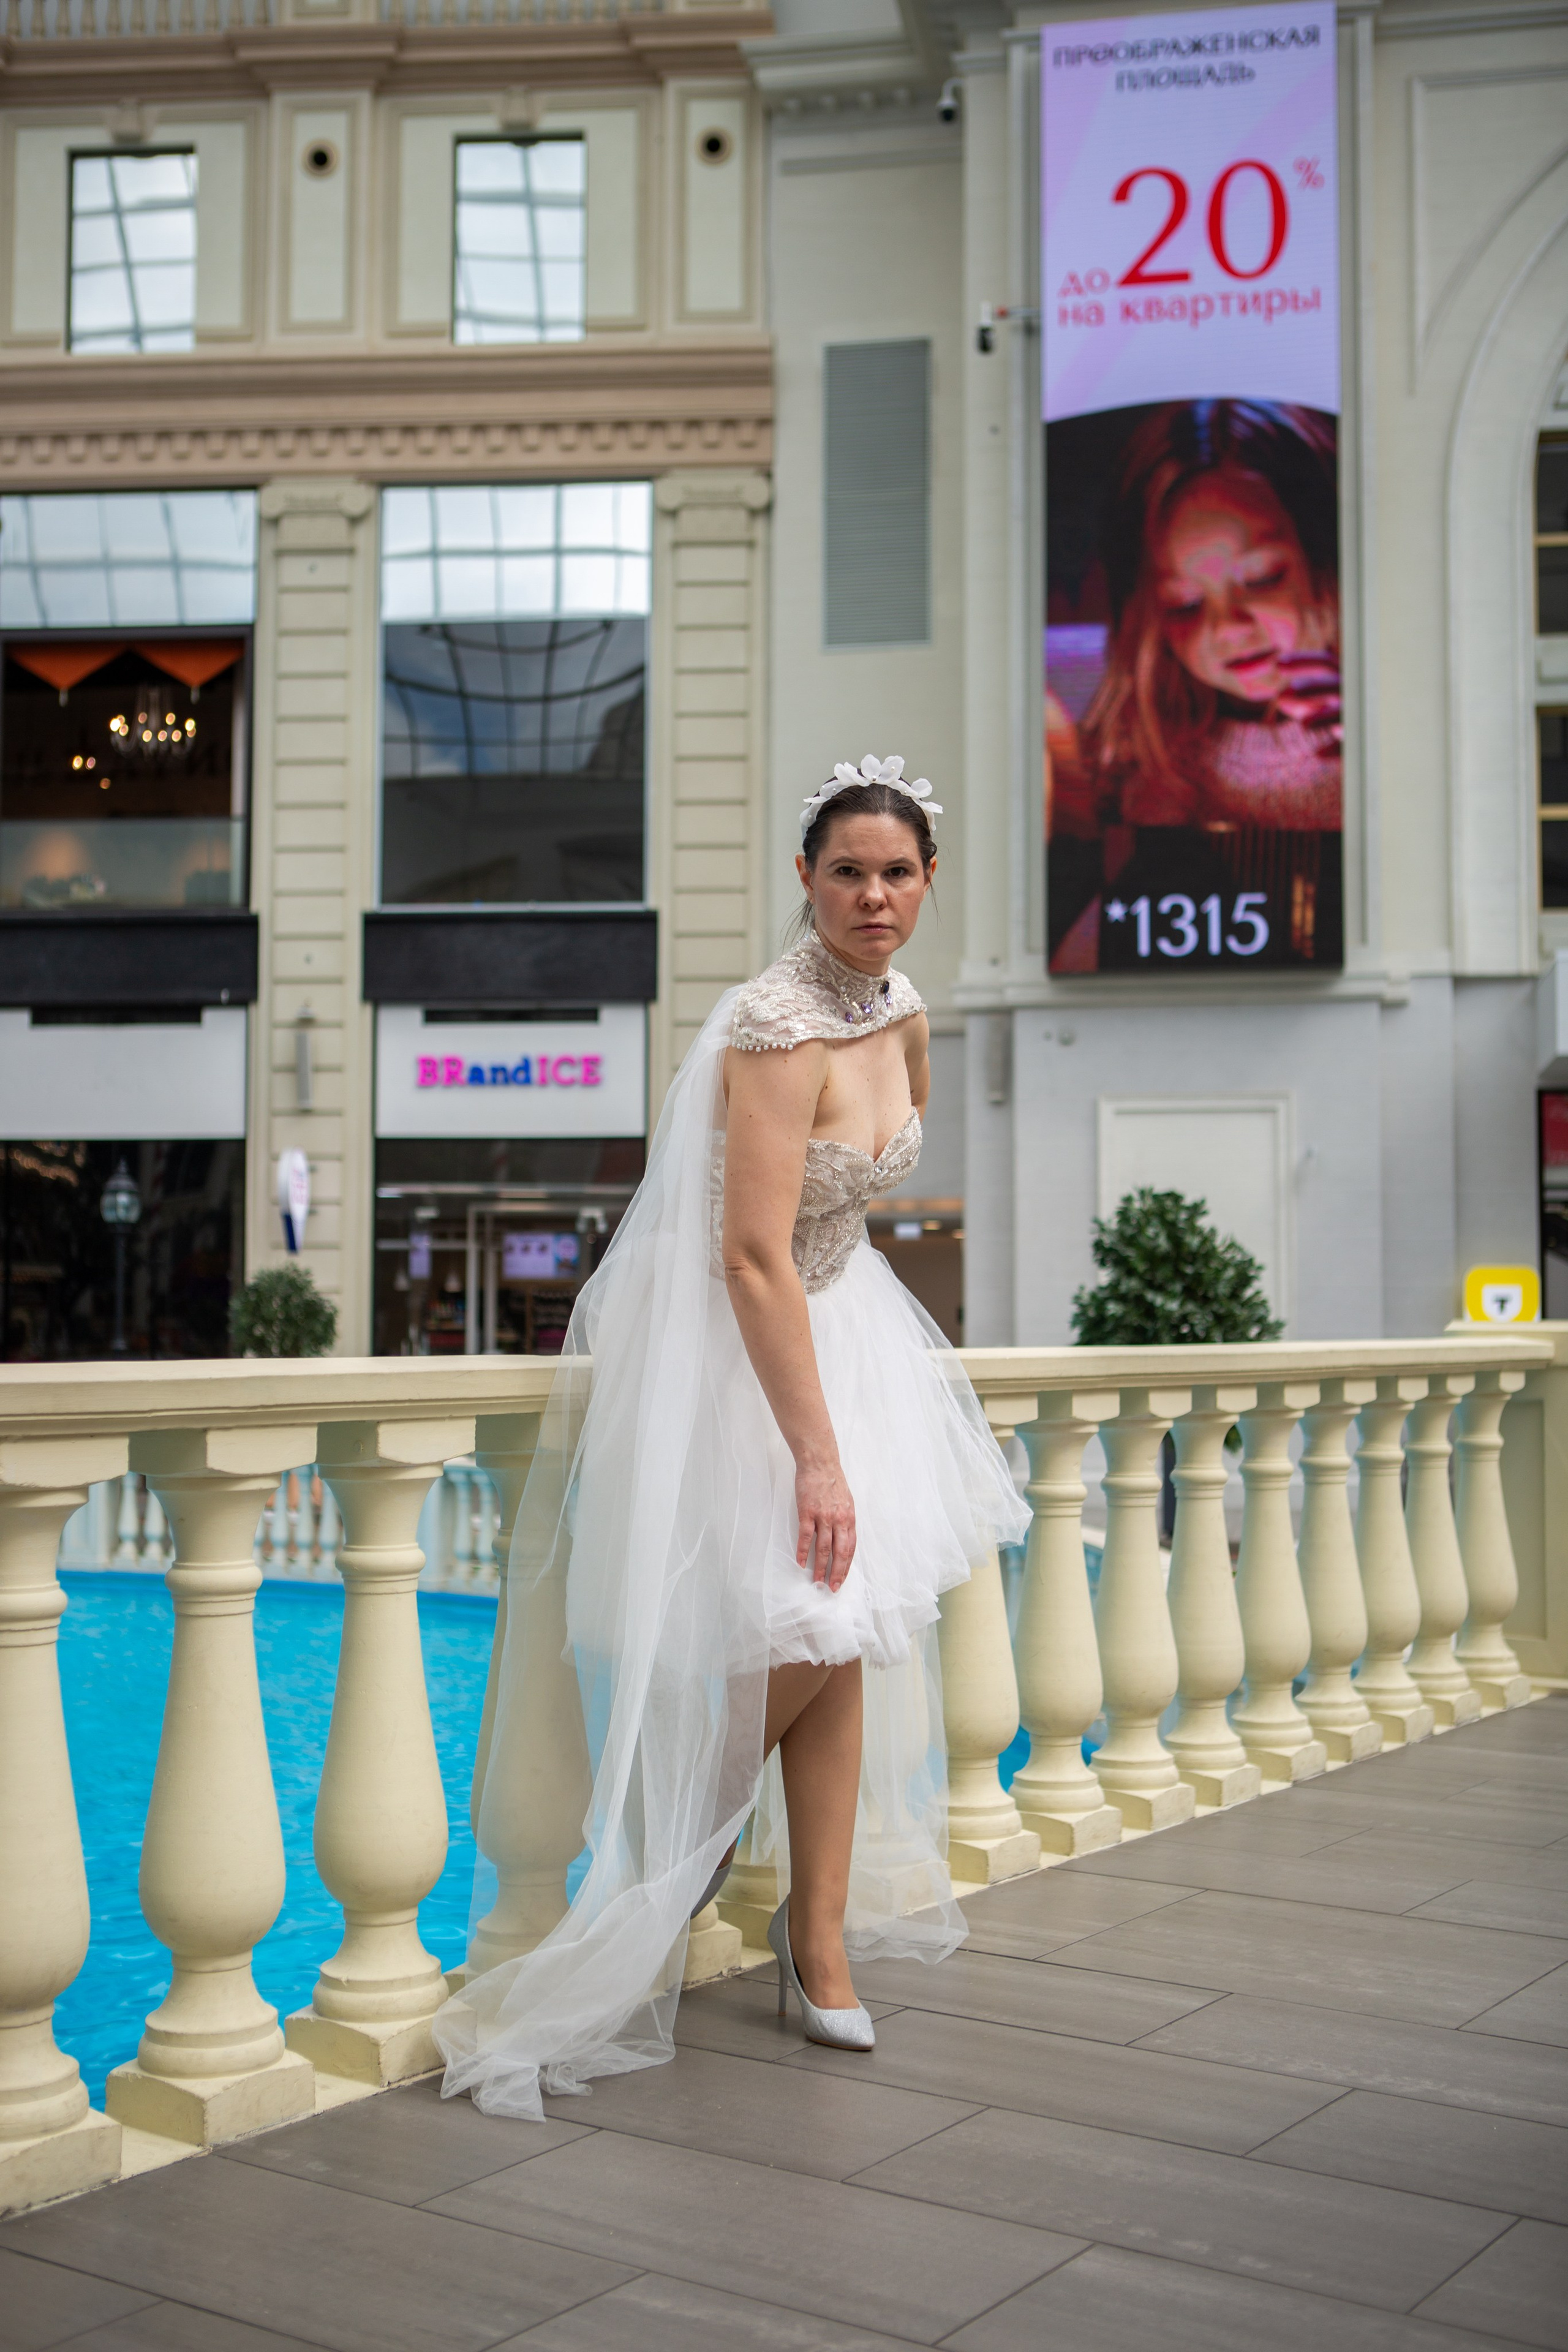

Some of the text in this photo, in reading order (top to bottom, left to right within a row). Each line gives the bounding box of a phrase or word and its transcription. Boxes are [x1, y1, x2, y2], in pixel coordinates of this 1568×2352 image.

[1053, 24, 1321, 68] ПРЕОБРАЖЕНСКАЯ
[1115, 62, 1256, 92] ПЛОЩАДЬ
[1058, 268, 1110, 298] до
[1058, 287, 1321, 329] на квартиры
